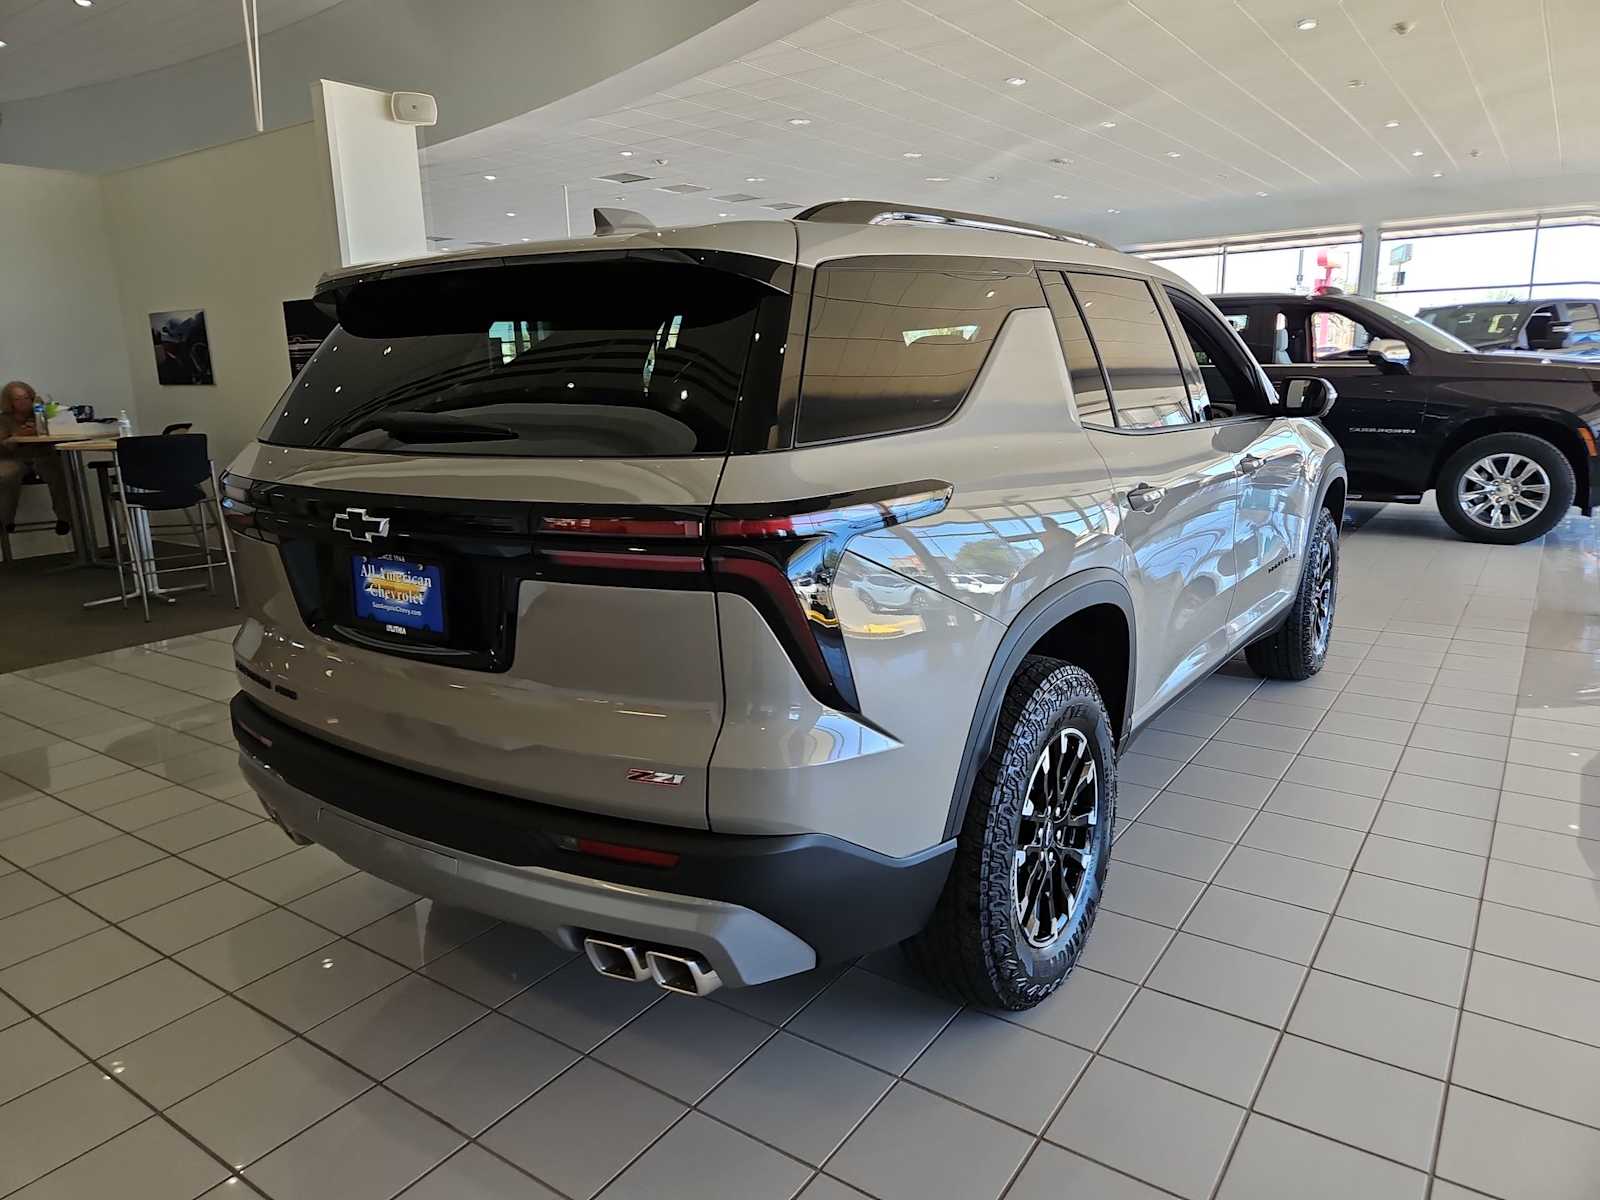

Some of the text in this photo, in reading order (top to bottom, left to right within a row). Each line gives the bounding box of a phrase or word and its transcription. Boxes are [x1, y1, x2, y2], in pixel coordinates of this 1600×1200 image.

[360, 563, 432, 588] All American
[368, 583, 425, 605] Chevrolet
